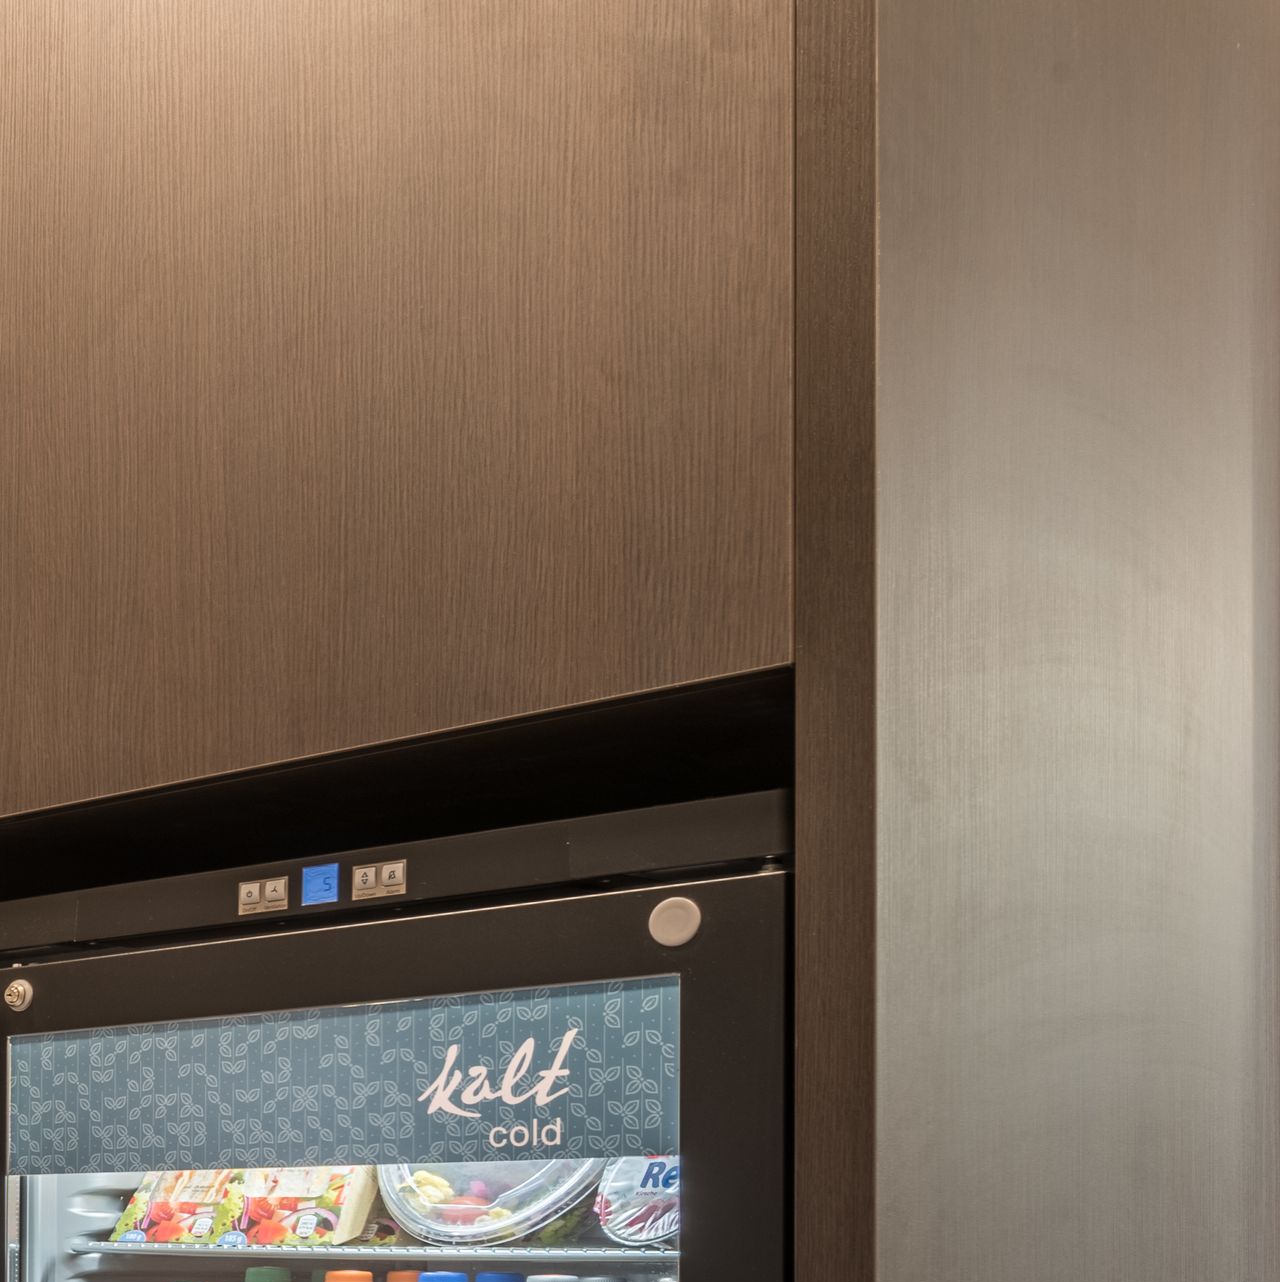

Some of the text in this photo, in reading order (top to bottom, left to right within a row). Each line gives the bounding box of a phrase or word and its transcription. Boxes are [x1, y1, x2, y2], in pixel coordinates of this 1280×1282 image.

[323, 876, 332, 892] 5
[417, 1028, 578, 1117] kalt
[489, 1117, 561, 1148] cold
[640, 1161, 679, 1189] Re
